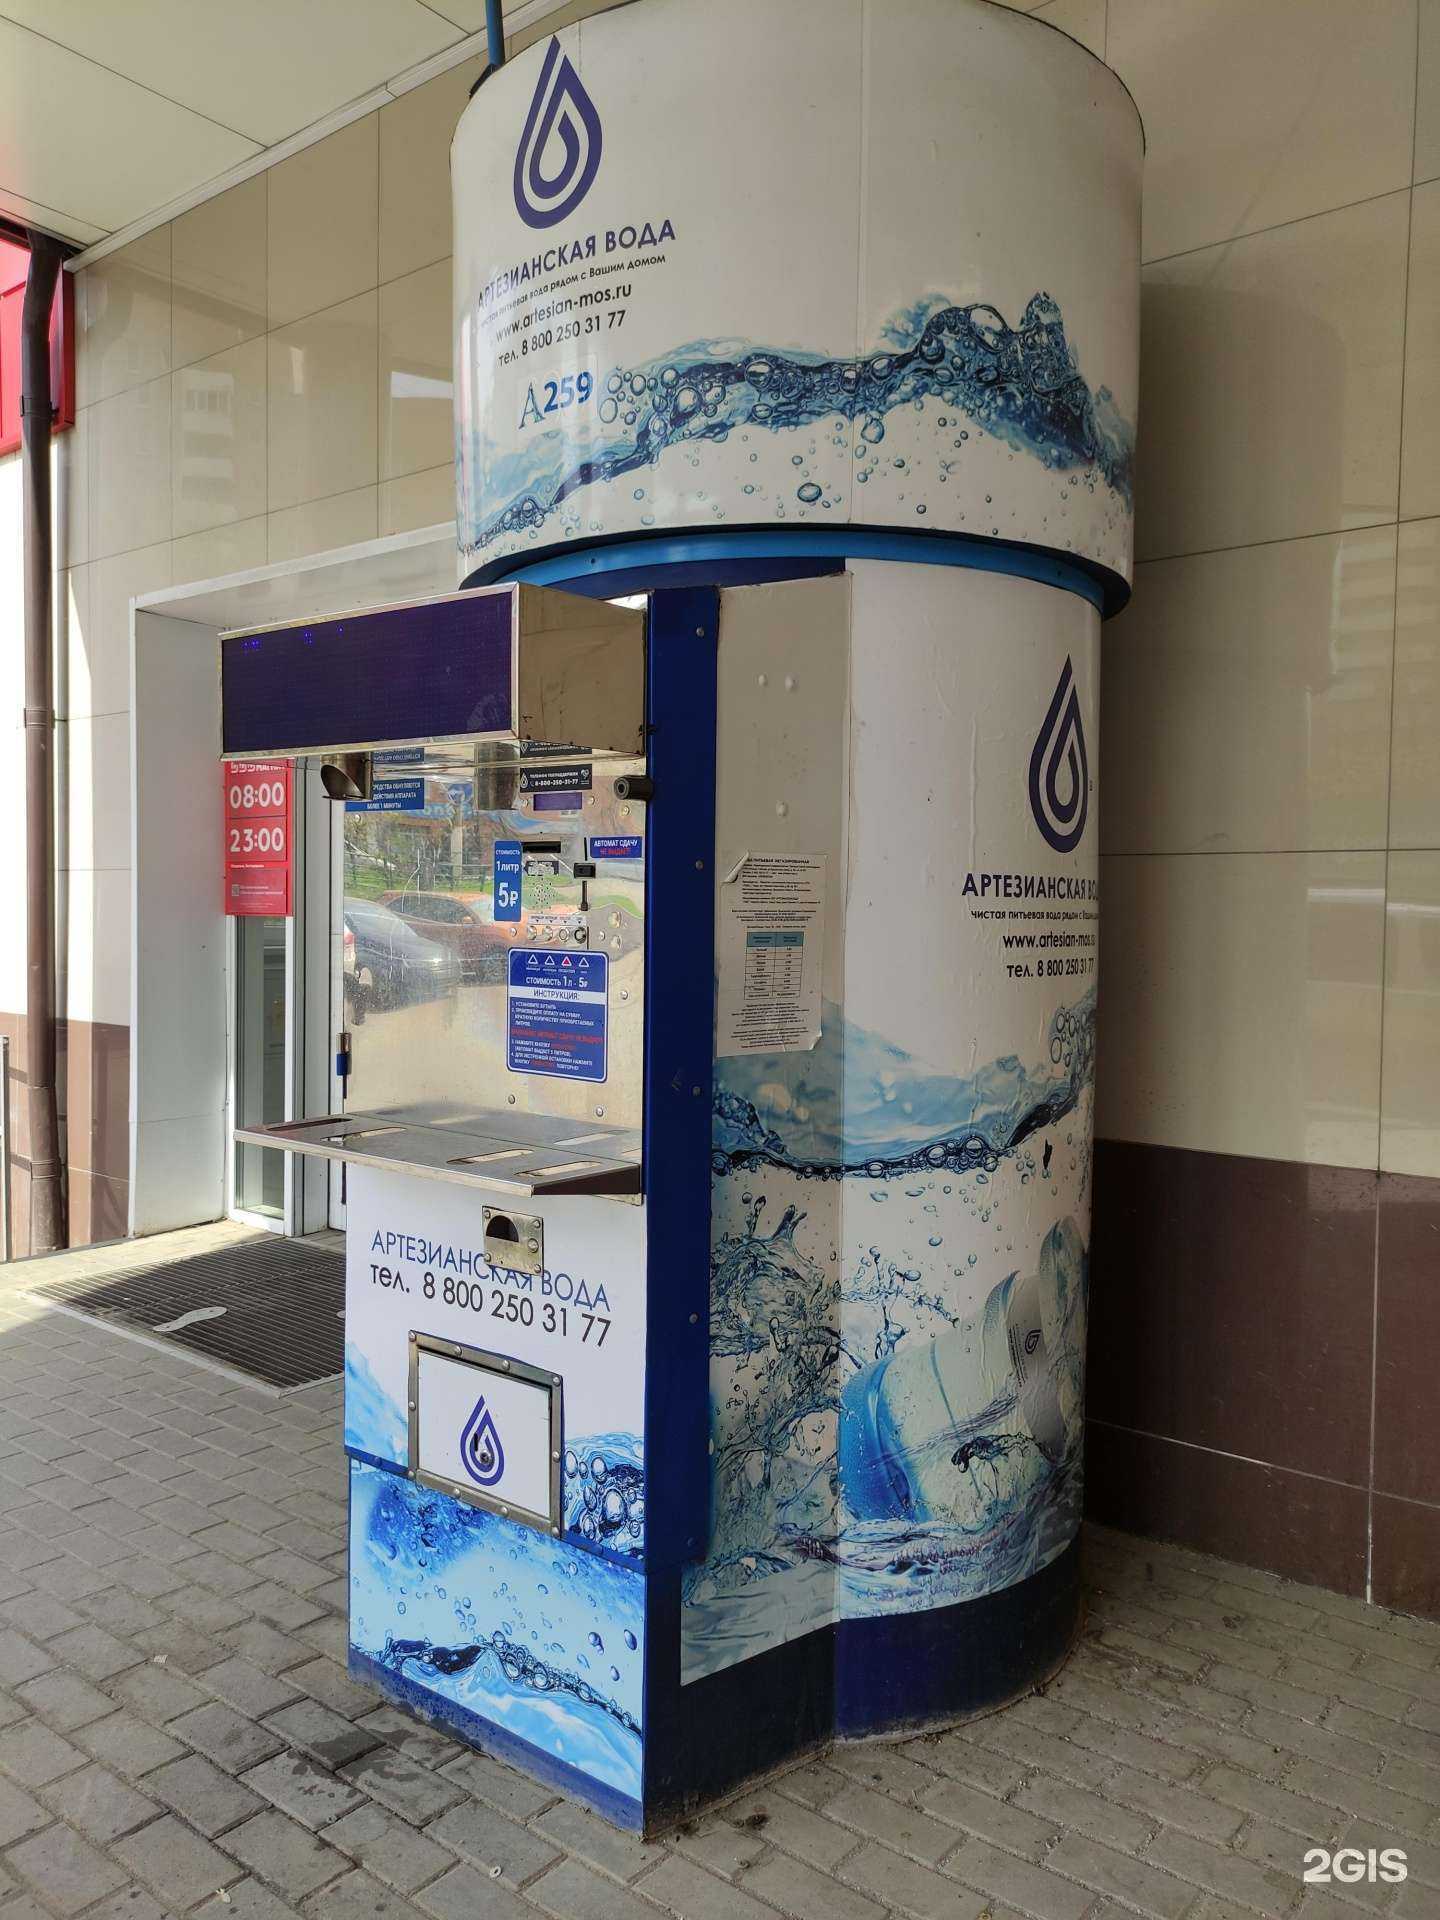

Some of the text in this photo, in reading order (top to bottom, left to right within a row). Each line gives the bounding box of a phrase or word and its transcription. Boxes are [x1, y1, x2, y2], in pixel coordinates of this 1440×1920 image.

[477, 219, 676, 312] АРТЕЗИАНСКАЯ ВОДА
[529, 285, 549, 300] вода
[550, 275, 579, 293] рядом
[580, 271, 587, 281] с
[589, 263, 624, 278] Вашим
[627, 254, 666, 271] домом
[496, 283, 632, 342] www.artesian-mos.ru
[498, 310, 626, 367] тел. 8 800 250 31 77
[230, 782, 285, 809] 08:00
[230, 827, 284, 852] 23:00
[594, 839, 638, 848] АВТОМАТ СДАЧУ
[961, 873, 1086, 900] АРТЕЗИАНСКАЯ
[971, 910, 1006, 920] чистая
[1008, 910, 1044, 920] питьевая
[526, 976, 561, 986] СТОИМОСТЬ
[1007, 964, 1034, 977] тел.
[1037, 960, 1044, 977] 8
[1047, 959, 1064, 977] 800
[1065, 958, 1079, 975] 250
[371, 1229, 611, 1312] АРТЕЗИАНСКАЯ ВОДА
[371, 1264, 611, 1347] тел. 8 800 250 31 77
